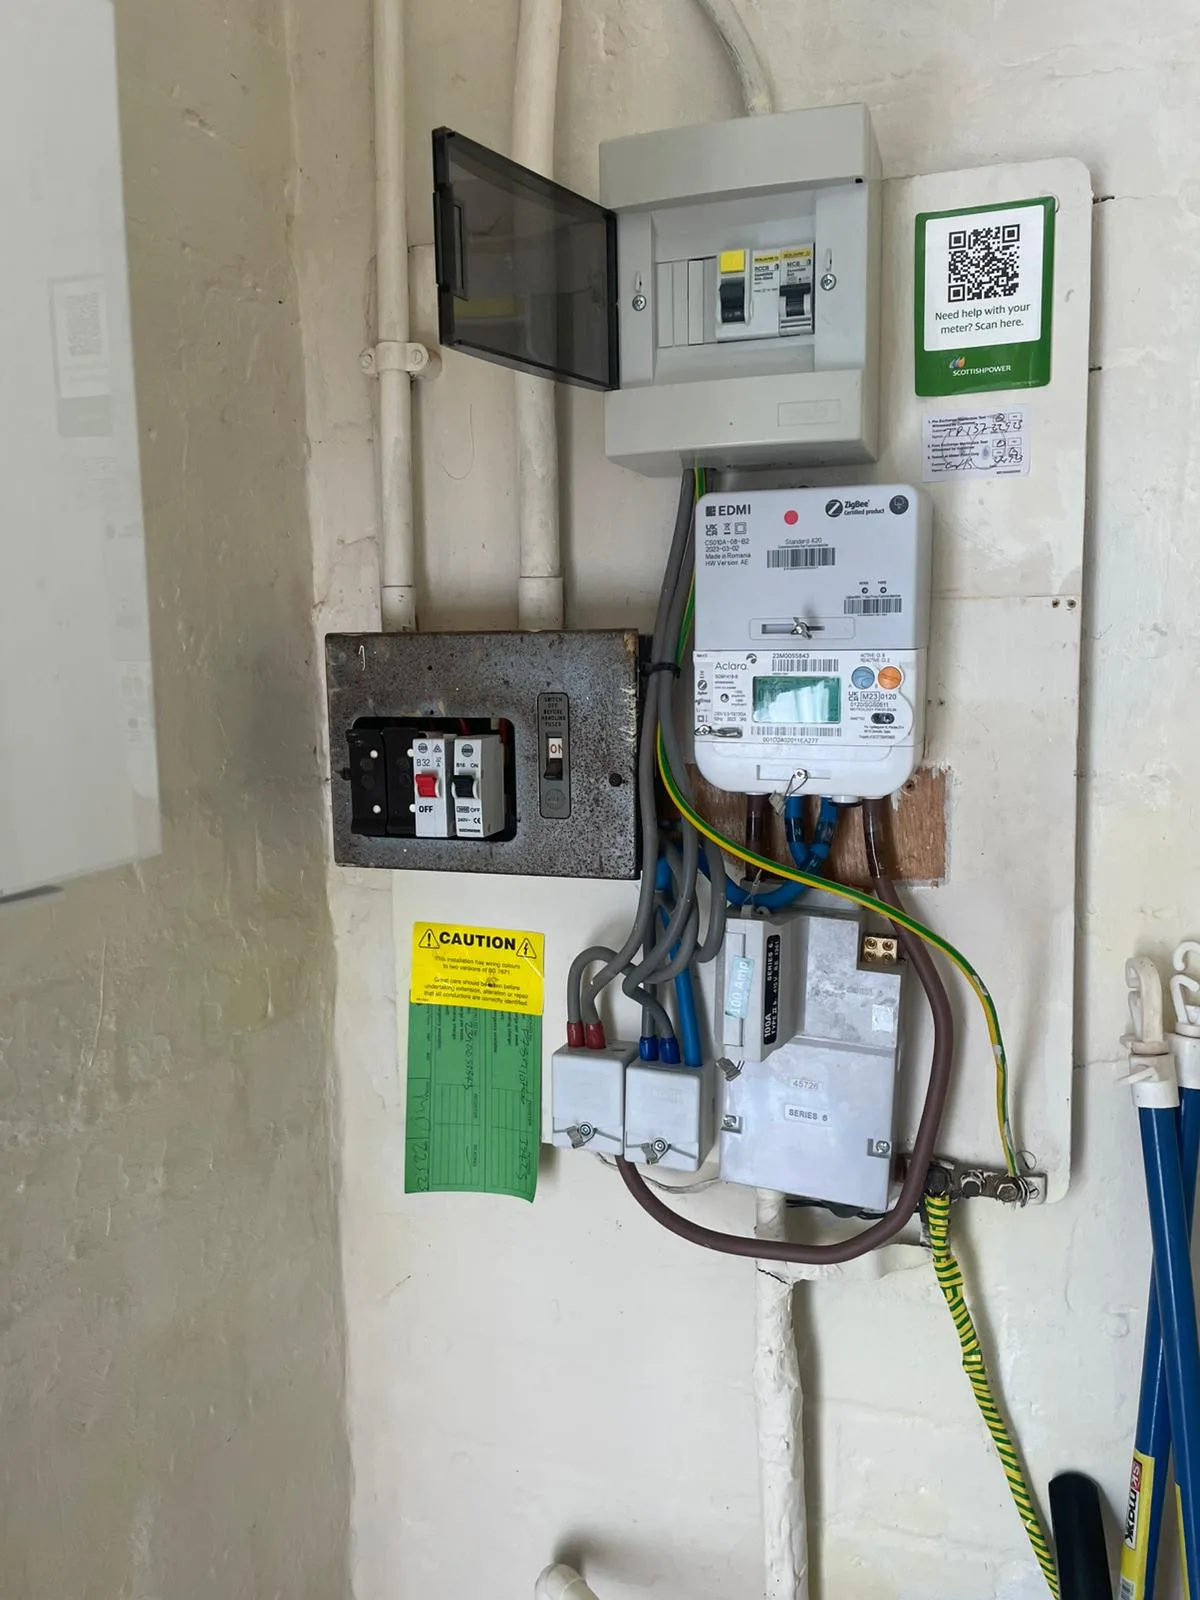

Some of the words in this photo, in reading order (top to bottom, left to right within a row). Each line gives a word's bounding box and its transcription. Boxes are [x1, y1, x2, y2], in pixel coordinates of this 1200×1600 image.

[935, 310, 960, 322] Need
[961, 307, 983, 320] help
[984, 304, 1006, 316] with
[1007, 303, 1031, 316] your
[940, 323, 973, 335] meter?
[975, 320, 998, 332] Scan
[999, 317, 1025, 330] here.
[953, 365, 1011, 377] SCOTTISHPOWER
[719, 504, 751, 516] EDMI
[845, 500, 869, 510] ZigBee
[865, 508, 885, 516] product
[715, 662, 747, 671] Aclara
[551, 744, 564, 754] ON
[416, 758, 431, 767] B32
[418, 805, 433, 813] OFF
[439, 931, 517, 950] CAUTION
[447, 957, 475, 965] installation
[766, 950, 774, 982] SERIES
[734, 960, 749, 990] Amp
[463, 979, 480, 987] should
[729, 992, 743, 1015] 100
[763, 1012, 772, 1038] 100A
[789, 1109, 818, 1121] SERIES
[821, 1114, 828, 1122] 6
